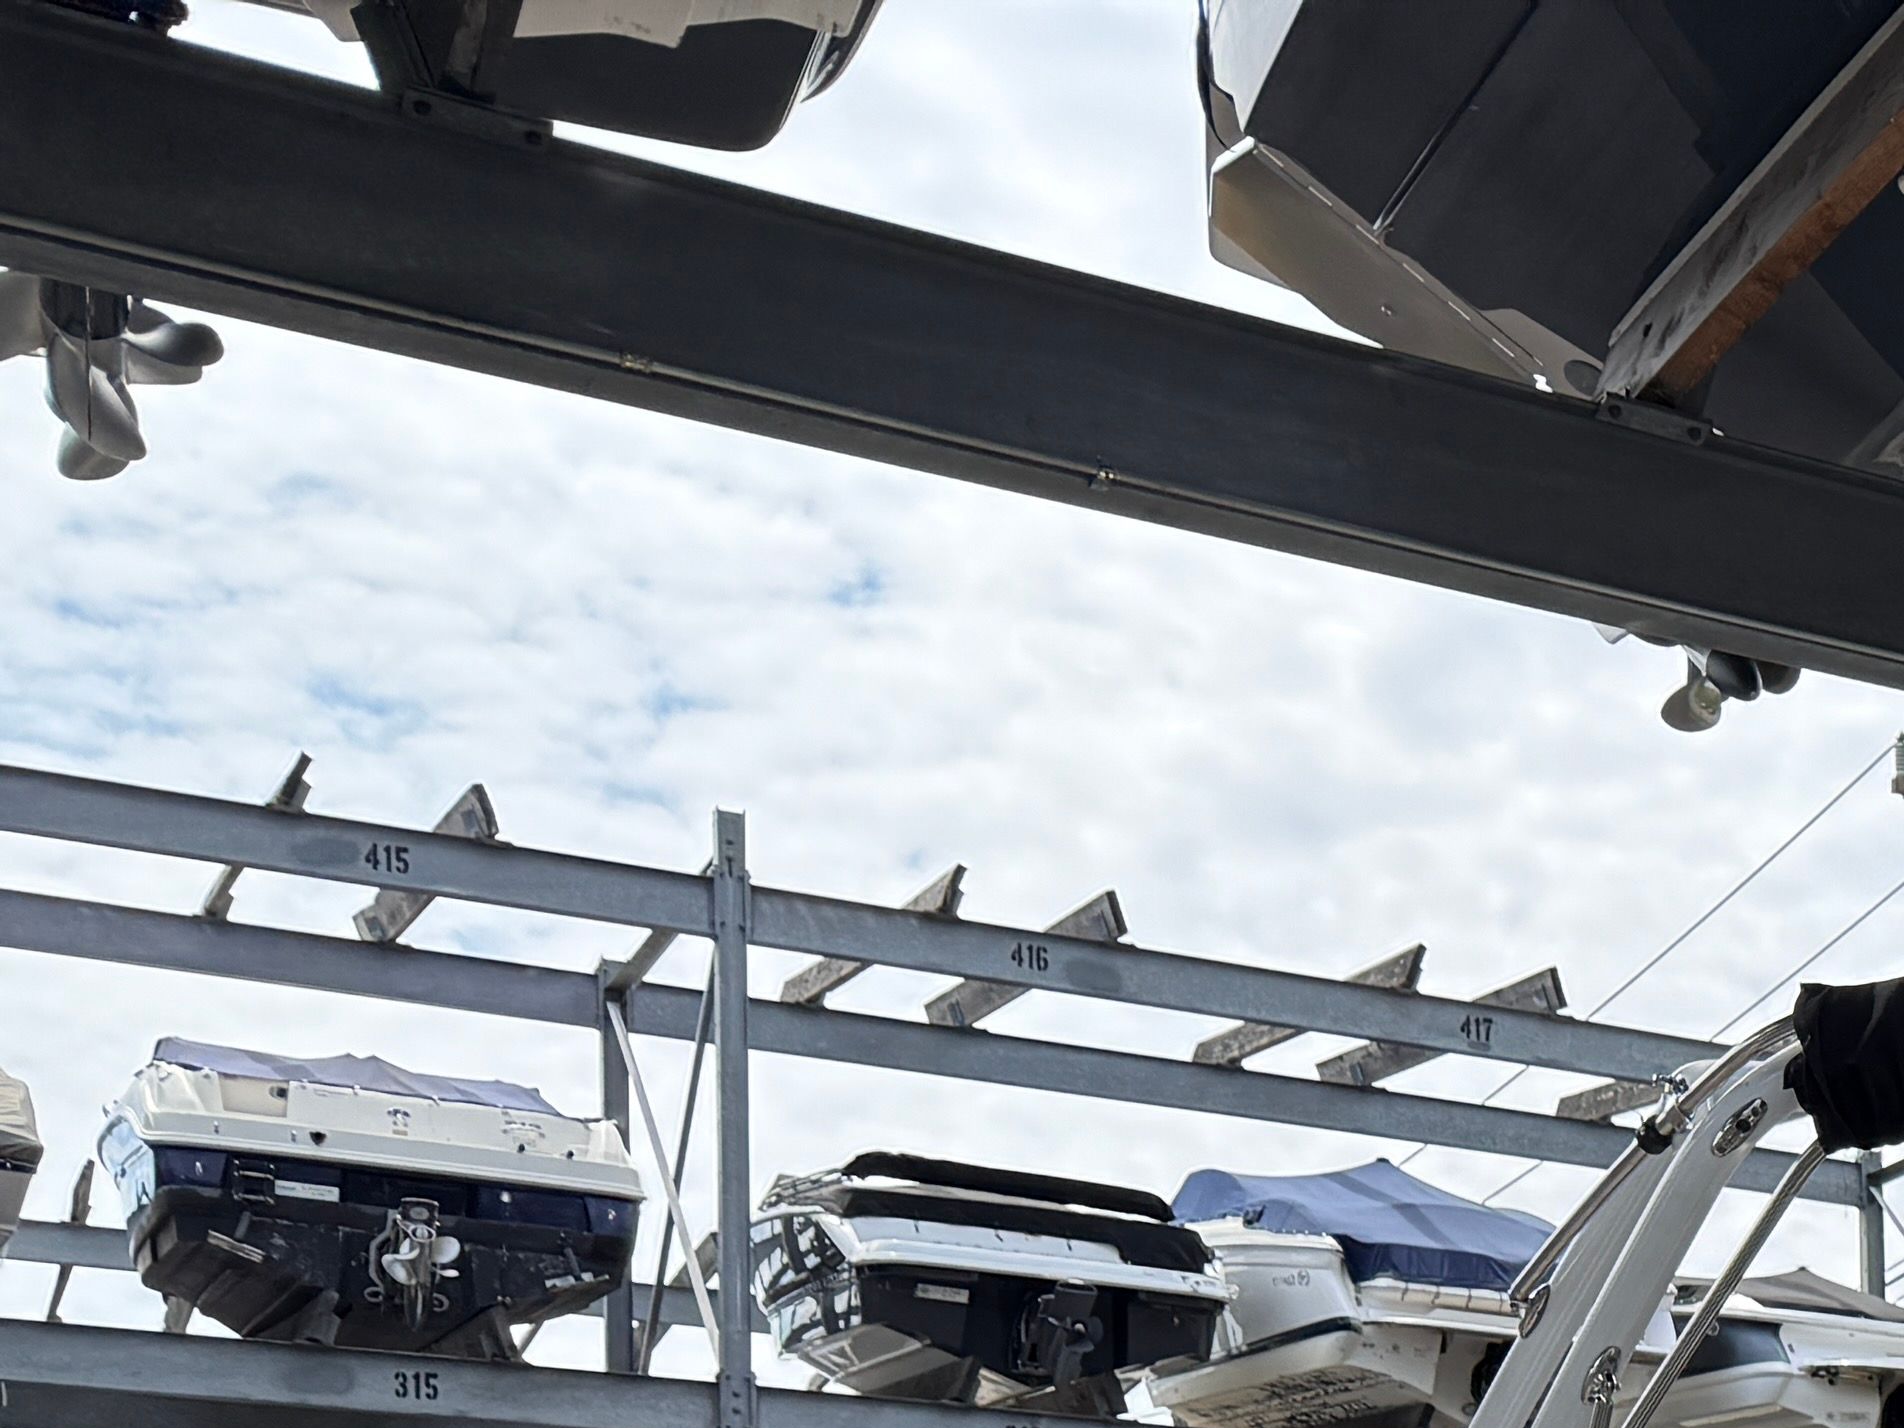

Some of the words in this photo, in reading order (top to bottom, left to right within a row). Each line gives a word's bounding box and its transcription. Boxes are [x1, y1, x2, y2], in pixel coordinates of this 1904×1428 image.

[365, 842, 410, 874] 415
[1011, 942, 1049, 971] 416
[1460, 1015, 1493, 1042] 417
[394, 1371, 439, 1400] 315
